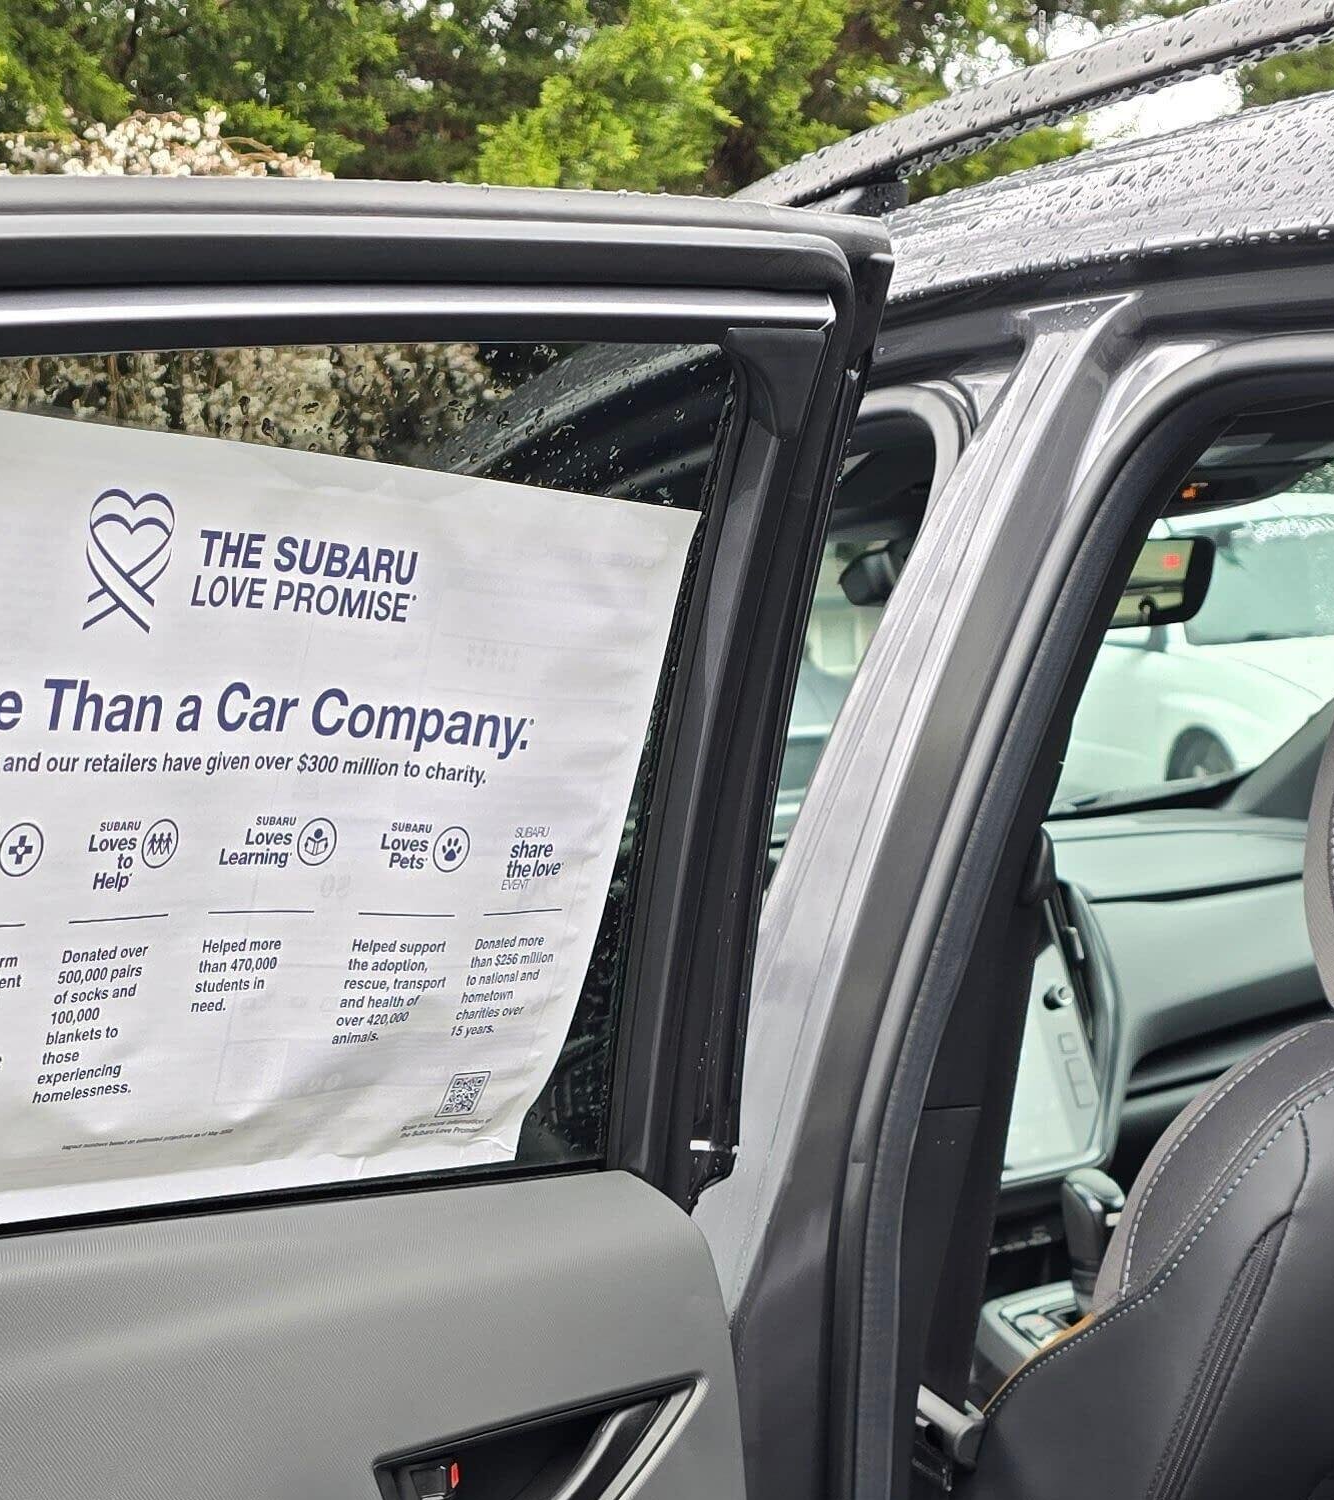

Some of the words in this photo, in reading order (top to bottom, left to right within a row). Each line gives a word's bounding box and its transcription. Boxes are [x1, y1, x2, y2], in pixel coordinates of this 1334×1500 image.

[200, 529, 266, 569] THE
[273, 536, 418, 585] SUBARU
[191, 575, 266, 609] LOVE
[273, 580, 411, 623] PROMISE
[43, 678, 163, 733] Than
[175, 694, 203, 732] a
[216, 681, 300, 733] Car
[311, 687, 529, 760] Company.
[2, 752, 42, 772] and
[46, 754, 80, 772] our
[83, 752, 157, 773] retailers
[162, 751, 202, 772] have
[206, 751, 250, 775] given
[254, 755, 293, 770] over
[297, 754, 339, 773] $300
[342, 755, 399, 777] million
[404, 760, 421, 778] to
[425, 760, 487, 788] charity.
[99, 821, 141, 832] SUBARU
[255, 816, 297, 827] SUBARU
[391, 822, 433, 834] SUBARU
[245, 828, 293, 846] Loves
[514, 826, 551, 839] SUBARU
[88, 834, 138, 852] Loves
[380, 833, 429, 852] Loves
[510, 840, 553, 859] share
[117, 853, 134, 870] to
[218, 848, 289, 868] Learning
[388, 853, 425, 870] Pets
[506, 860, 532, 878] the
[532, 860, 561, 877] love
[92, 872, 129, 892] Help
[501, 879, 531, 891] EVENT
[202, 938, 247, 956] Helped
[248, 939, 282, 952] more
[351, 939, 397, 956] Helped
[398, 940, 447, 956] support
[474, 936, 517, 951] Donated
[517, 936, 545, 947] more
[61, 946, 118, 964] Donated
[120, 945, 149, 959] over
[470, 955, 493, 969] than
[519, 951, 554, 965] million
[198, 959, 227, 973] than
[230, 956, 278, 973] 470,000
[348, 958, 369, 971] the
[371, 958, 429, 975] adoption,
[57, 967, 108, 985] 500,000
[110, 964, 143, 983] pairs
[466, 974, 477, 987] to
[478, 970, 519, 986] national
[520, 969, 541, 982] and
[194, 978, 250, 993] students
[253, 976, 265, 990] in
[343, 979, 390, 992] rescue,
[393, 976, 447, 992] transport
[53, 990, 68, 1005] of
[70, 987, 109, 1004] socks
[111, 984, 137, 999] and
[339, 995, 365, 1008] and
[367, 995, 405, 1008] health
[406, 994, 421, 1007] of
[460, 990, 514, 1004] hometown
[190, 998, 226, 1013] need.
[455, 1007, 500, 1021] charities
[502, 1005, 525, 1017] over
[50, 1007, 100, 1026] 100,000
[336, 1016, 365, 1027] over
[366, 1011, 410, 1026] 420,000
[45, 1027, 102, 1046] blankets
[105, 1026, 119, 1039] to
[331, 1031, 379, 1045] animals.
[450, 1025, 464, 1037] 15
[464, 1024, 495, 1039] years.
[42, 1051, 80, 1066] those
[37, 1063, 122, 1087] experiencing
[32, 1082, 132, 1104] homelessness.
